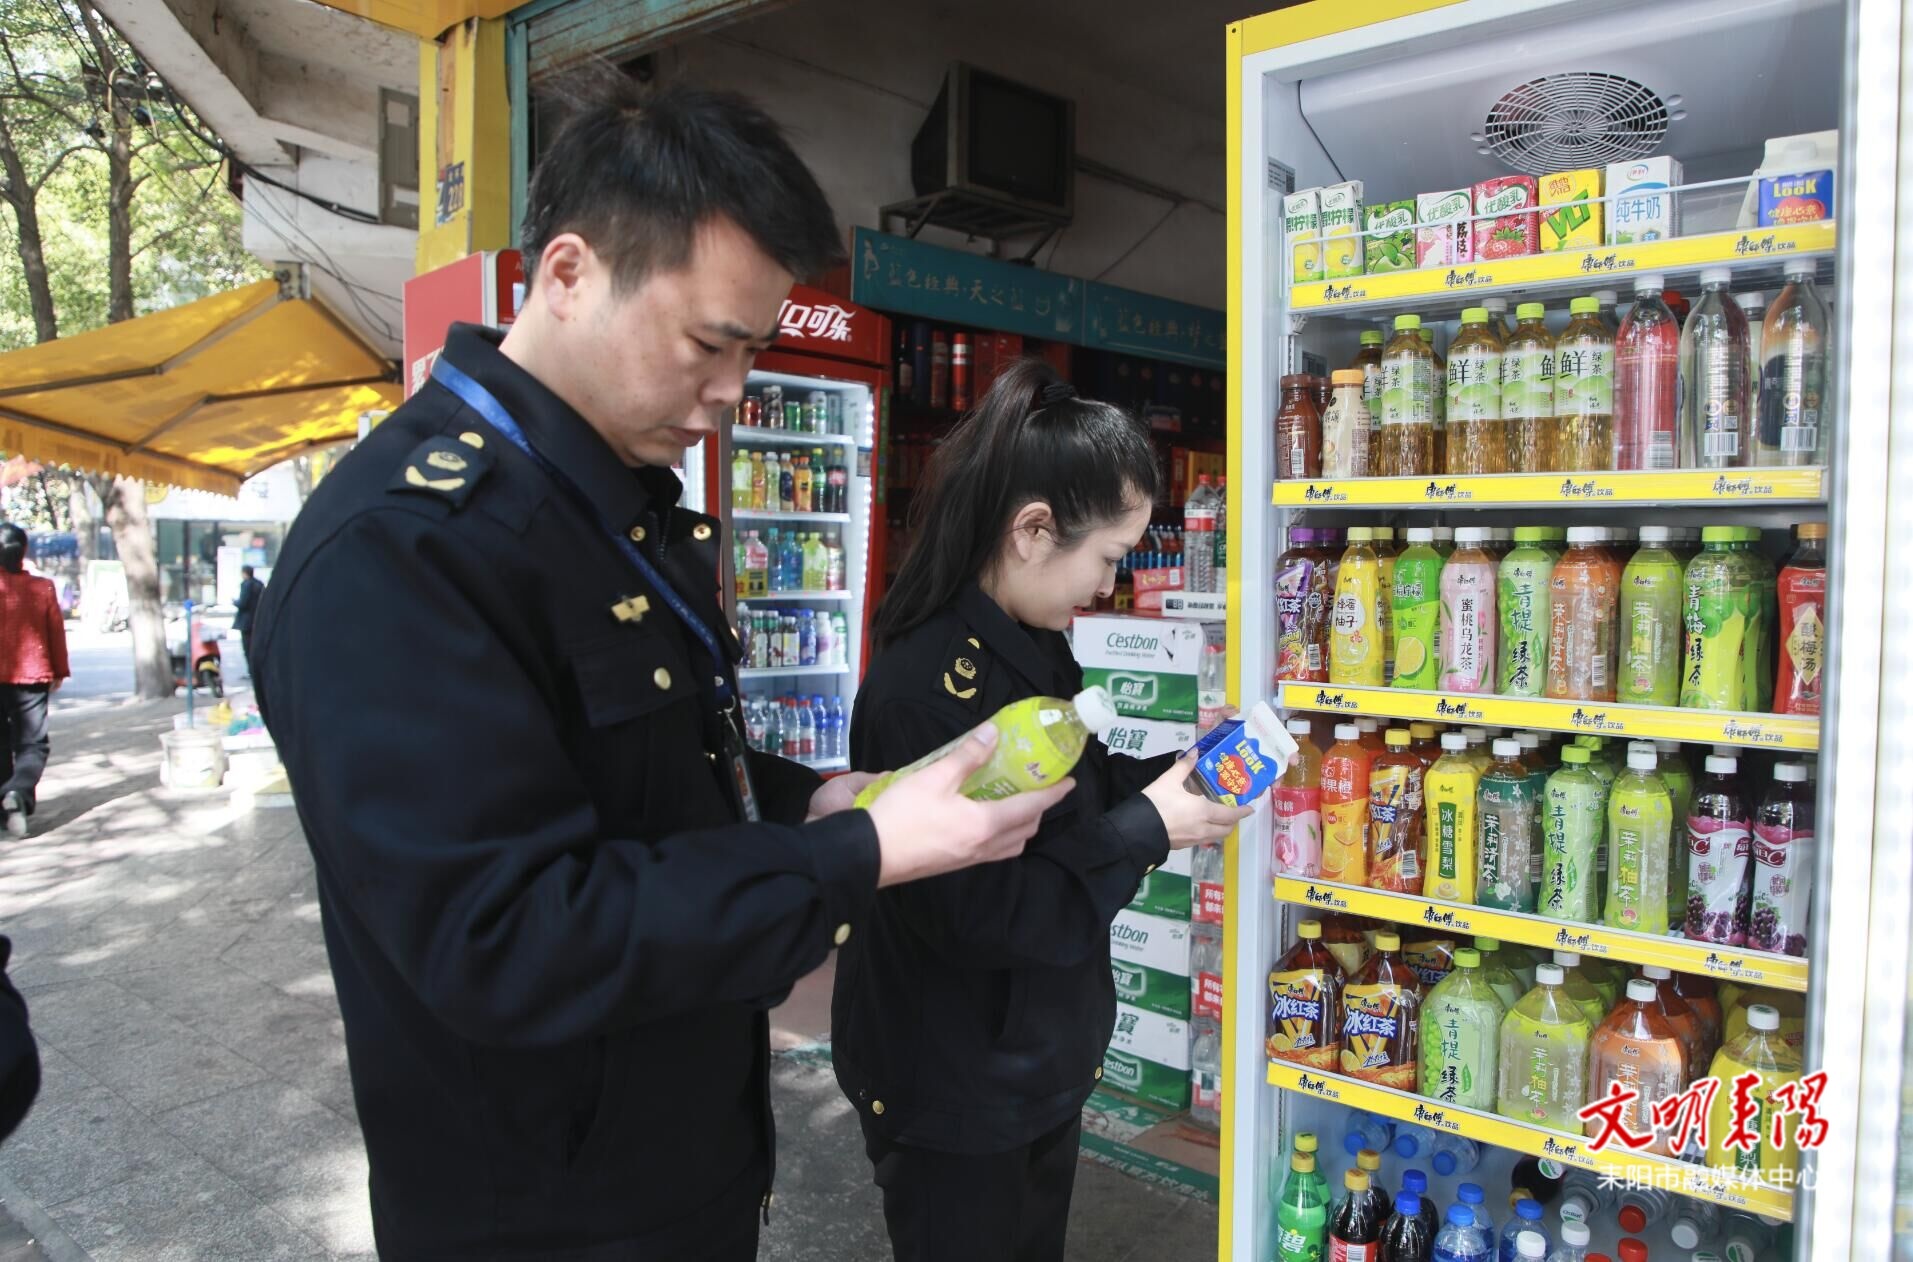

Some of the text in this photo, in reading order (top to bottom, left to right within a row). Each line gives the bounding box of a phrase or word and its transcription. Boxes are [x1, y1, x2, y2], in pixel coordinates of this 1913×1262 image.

[1427, 196, 1465, 219] 优酸乳
[1616, 196, 1660, 224] 纯牛奶
[1391, 363, 1400, 387] 绿茶
[1475, 357, 1485, 381] 绿茶
[1510, 357, 1521, 379] 绿茶
[1560, 350, 1588, 379] 鲜
[1591, 351, 1602, 375] 绿茶
[1460, 598, 1474, 671] 蜜桃乌龙茶
[1800, 622, 1819, 672] 酸梅汤
[1440, 808, 1454, 871] 冰糖雪梨
[1273, 992, 1321, 1020] 冰红茶
[1343, 1007, 1398, 1038] 冰红茶
